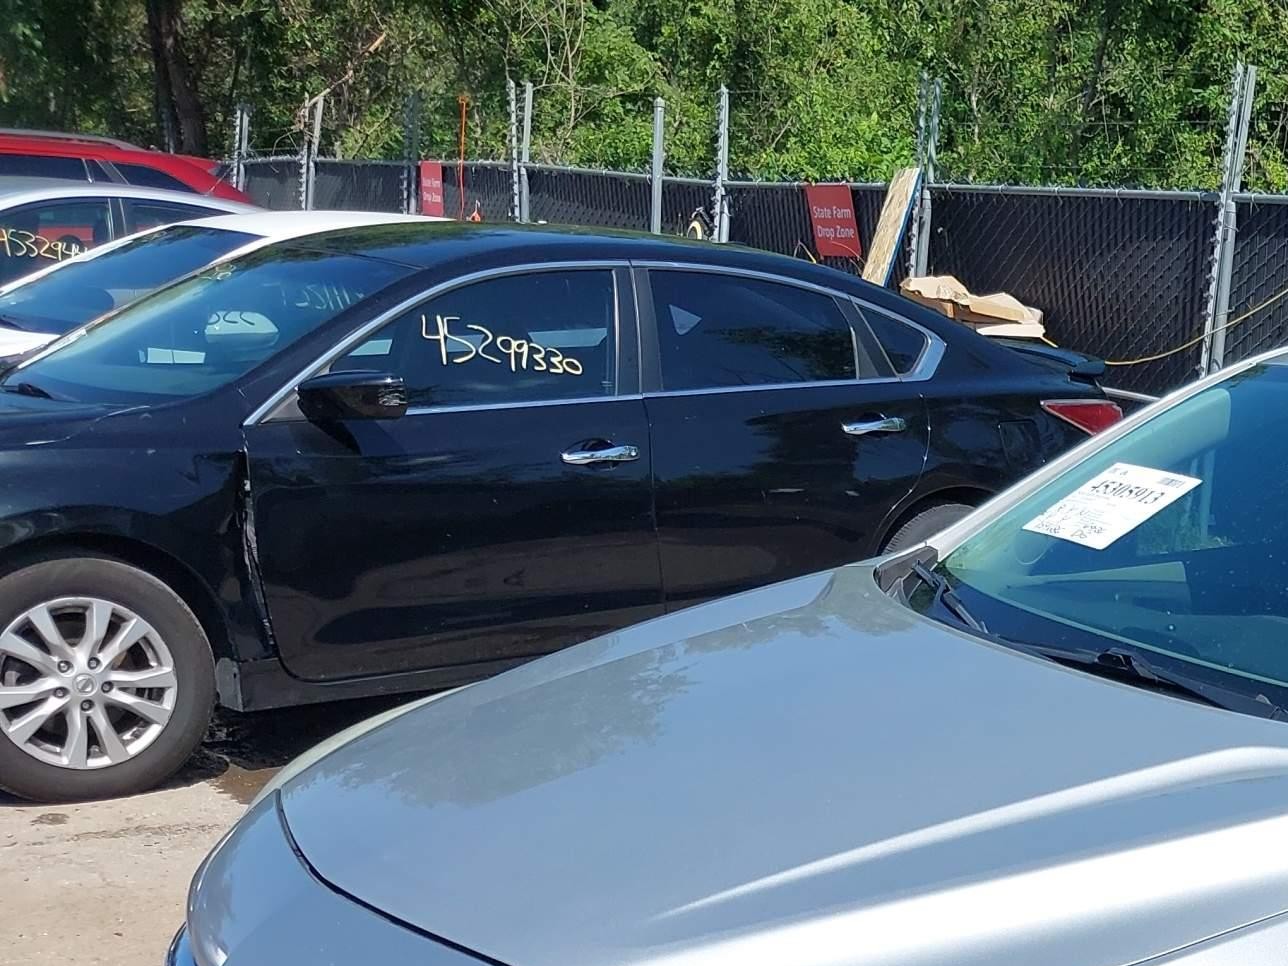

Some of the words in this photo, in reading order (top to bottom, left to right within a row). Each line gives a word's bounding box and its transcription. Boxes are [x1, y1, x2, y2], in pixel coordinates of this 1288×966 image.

[813, 206, 832, 218] State
[833, 206, 851, 218] Farm
[817, 225, 834, 240] Drop
[836, 226, 854, 238] Zone
[421, 313, 583, 376] 45299330
[1090, 479, 1166, 505] 45305913
